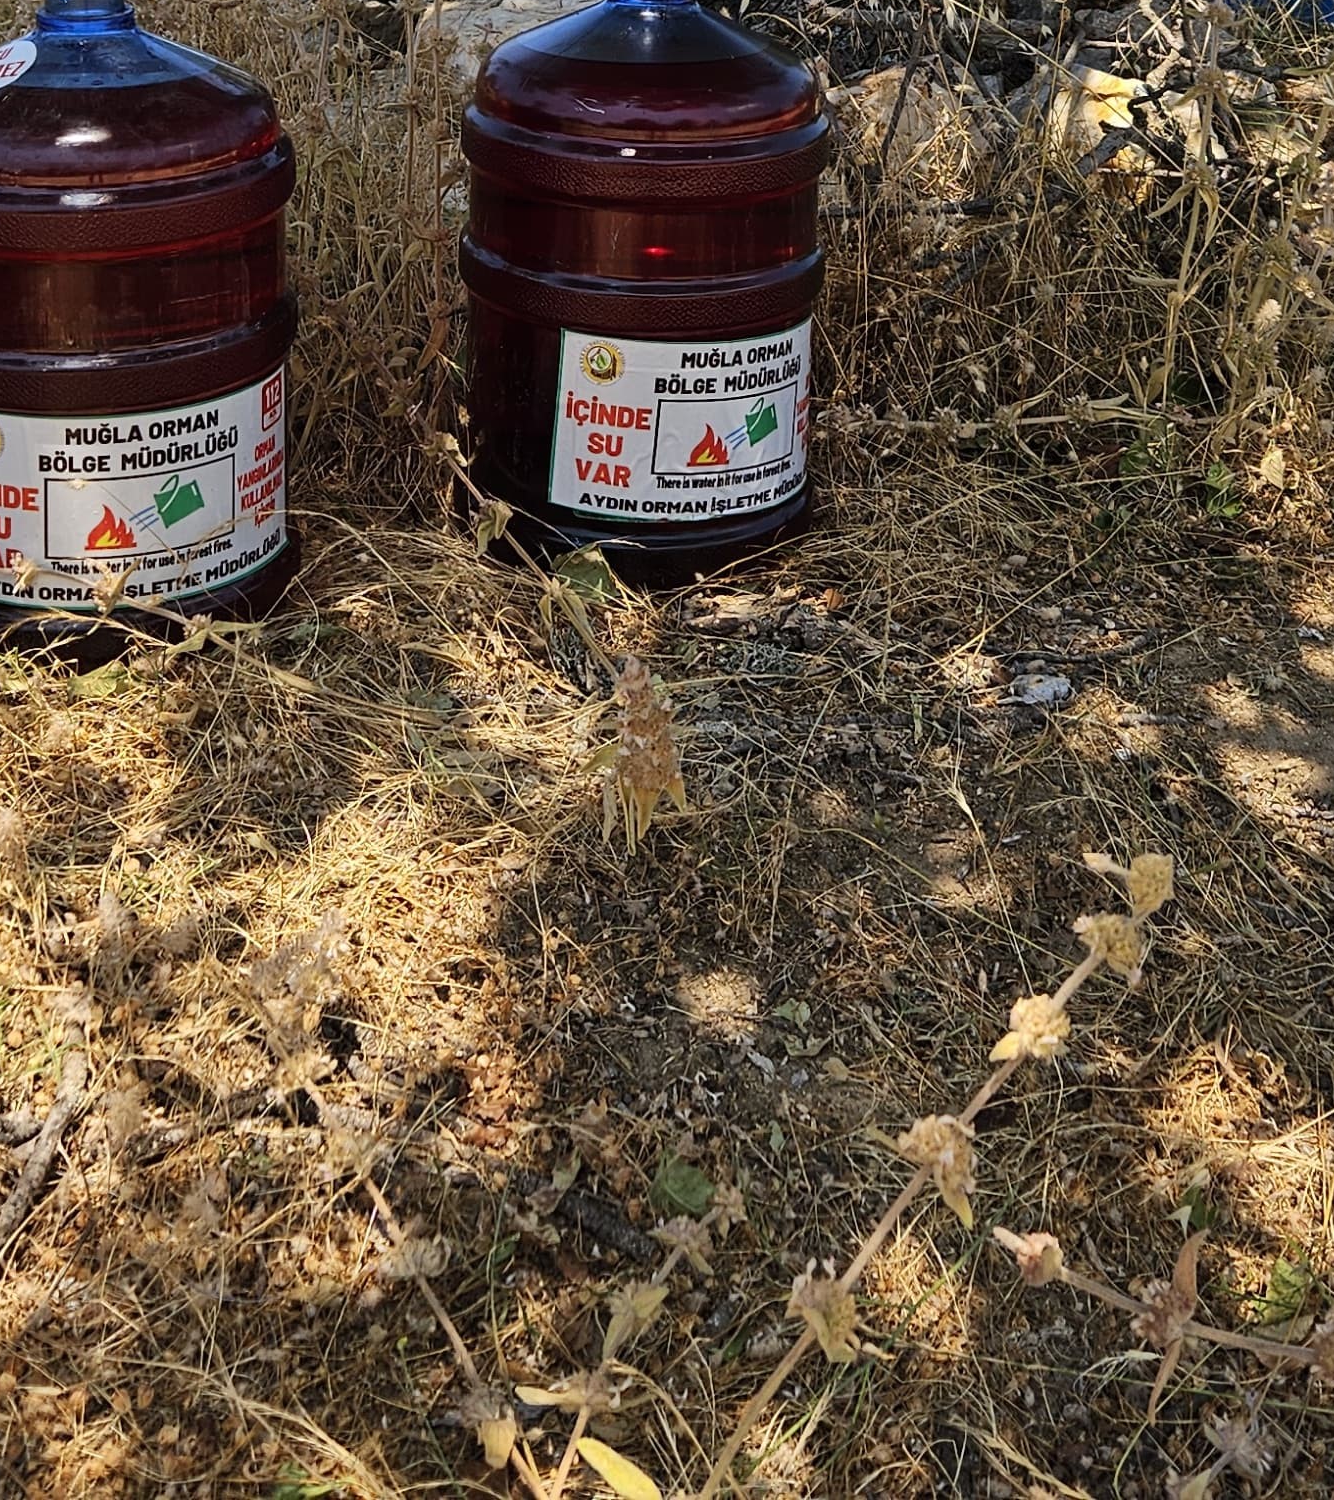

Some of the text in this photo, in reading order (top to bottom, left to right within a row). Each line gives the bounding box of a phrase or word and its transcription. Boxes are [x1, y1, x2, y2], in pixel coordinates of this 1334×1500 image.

[681, 337, 794, 369] MUĞLA ORMAN
[654, 353, 802, 395] BÖLGE MÜDÜRLÜĞÜ
[265, 380, 281, 407] 112
[566, 390, 653, 431] İÇİNDE
[65, 409, 219, 446] MUĞLA ORMAN
[38, 424, 239, 473] BÖLGE MÜDÜRLÜĞÜ
[587, 432, 623, 457] SU
[575, 458, 631, 489] VAR
[656, 476, 681, 489] There
[691, 476, 717, 489] water
[579, 492, 638, 513] AYDIN
[641, 500, 708, 514] ORMAN
[710, 488, 772, 514] İŞLETME
[51, 560, 80, 575] There
[142, 556, 157, 570] for
[158, 553, 175, 568] use
